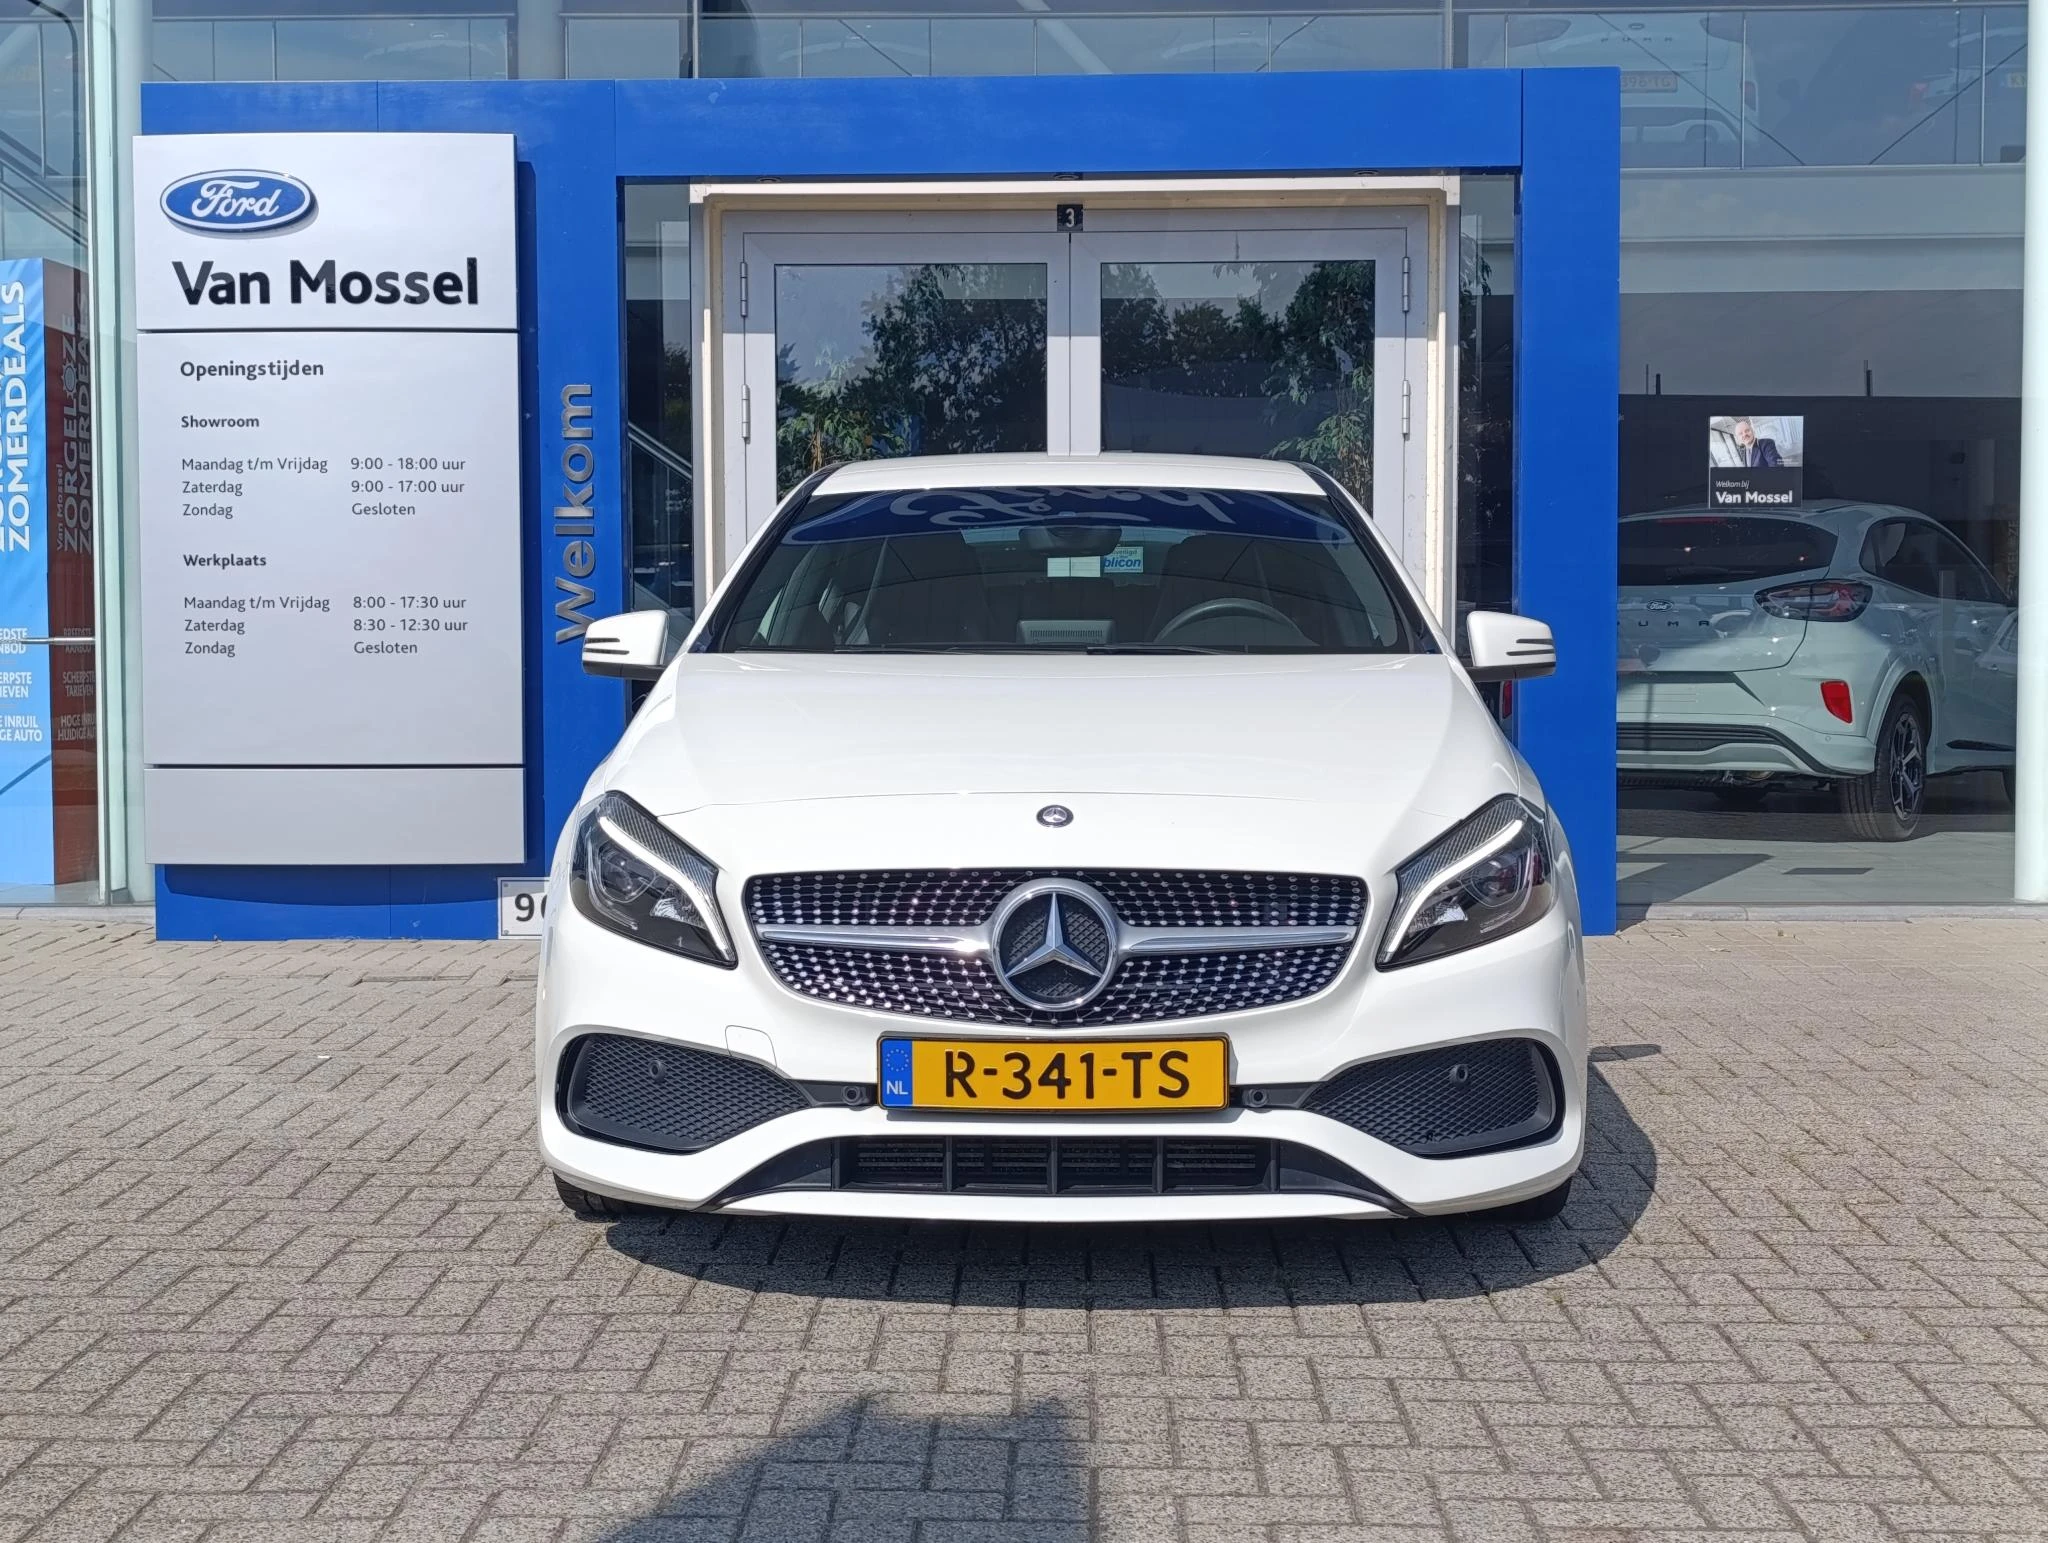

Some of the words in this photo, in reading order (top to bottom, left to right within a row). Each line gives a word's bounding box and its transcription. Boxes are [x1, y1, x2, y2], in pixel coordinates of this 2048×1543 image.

[191, 179, 282, 218] Ford
[1065, 208, 1075, 228] 3
[172, 260, 271, 306] Van
[289, 257, 479, 306] Mossel
[180, 360, 324, 381] Openingstijden
[2, 280, 30, 552] ZOMERDEALS
[181, 415, 260, 428] Showroom
[182, 457, 244, 474] Maandag
[247, 457, 273, 471] t/m
[277, 457, 329, 474] Vrijdag
[350, 457, 384, 470] 9:00
[397, 457, 438, 470] 18:00
[442, 460, 466, 470] uur
[182, 480, 244, 497] Zaterdag
[351, 480, 384, 493] 9:00
[398, 480, 437, 493] 17:00
[441, 482, 465, 493] uur
[1715, 491, 1742, 504] Van
[1745, 490, 1793, 504] Mossel
[182, 502, 234, 519] Zondag
[351, 502, 416, 516] Gesloten
[554, 383, 596, 644] Welkom
[183, 553, 267, 570] Werkplaats
[184, 596, 246, 612] Maandag
[249, 596, 276, 609] t/m
[279, 596, 331, 612] Vrijdag
[353, 596, 386, 609] 8:00
[399, 596, 439, 609] 17:30
[443, 599, 467, 609] uur
[184, 618, 246, 635] Zaterdag
[353, 618, 386, 631] 8:30
[399, 618, 440, 631] 12:30
[444, 621, 468, 631] uur
[185, 641, 236, 657] Zondag
[353, 641, 418, 654] Gesloten
[15, 729, 43, 742] AUTO
[944, 1050, 1191, 1099] R-341-TS
[885, 1080, 909, 1095] NL
